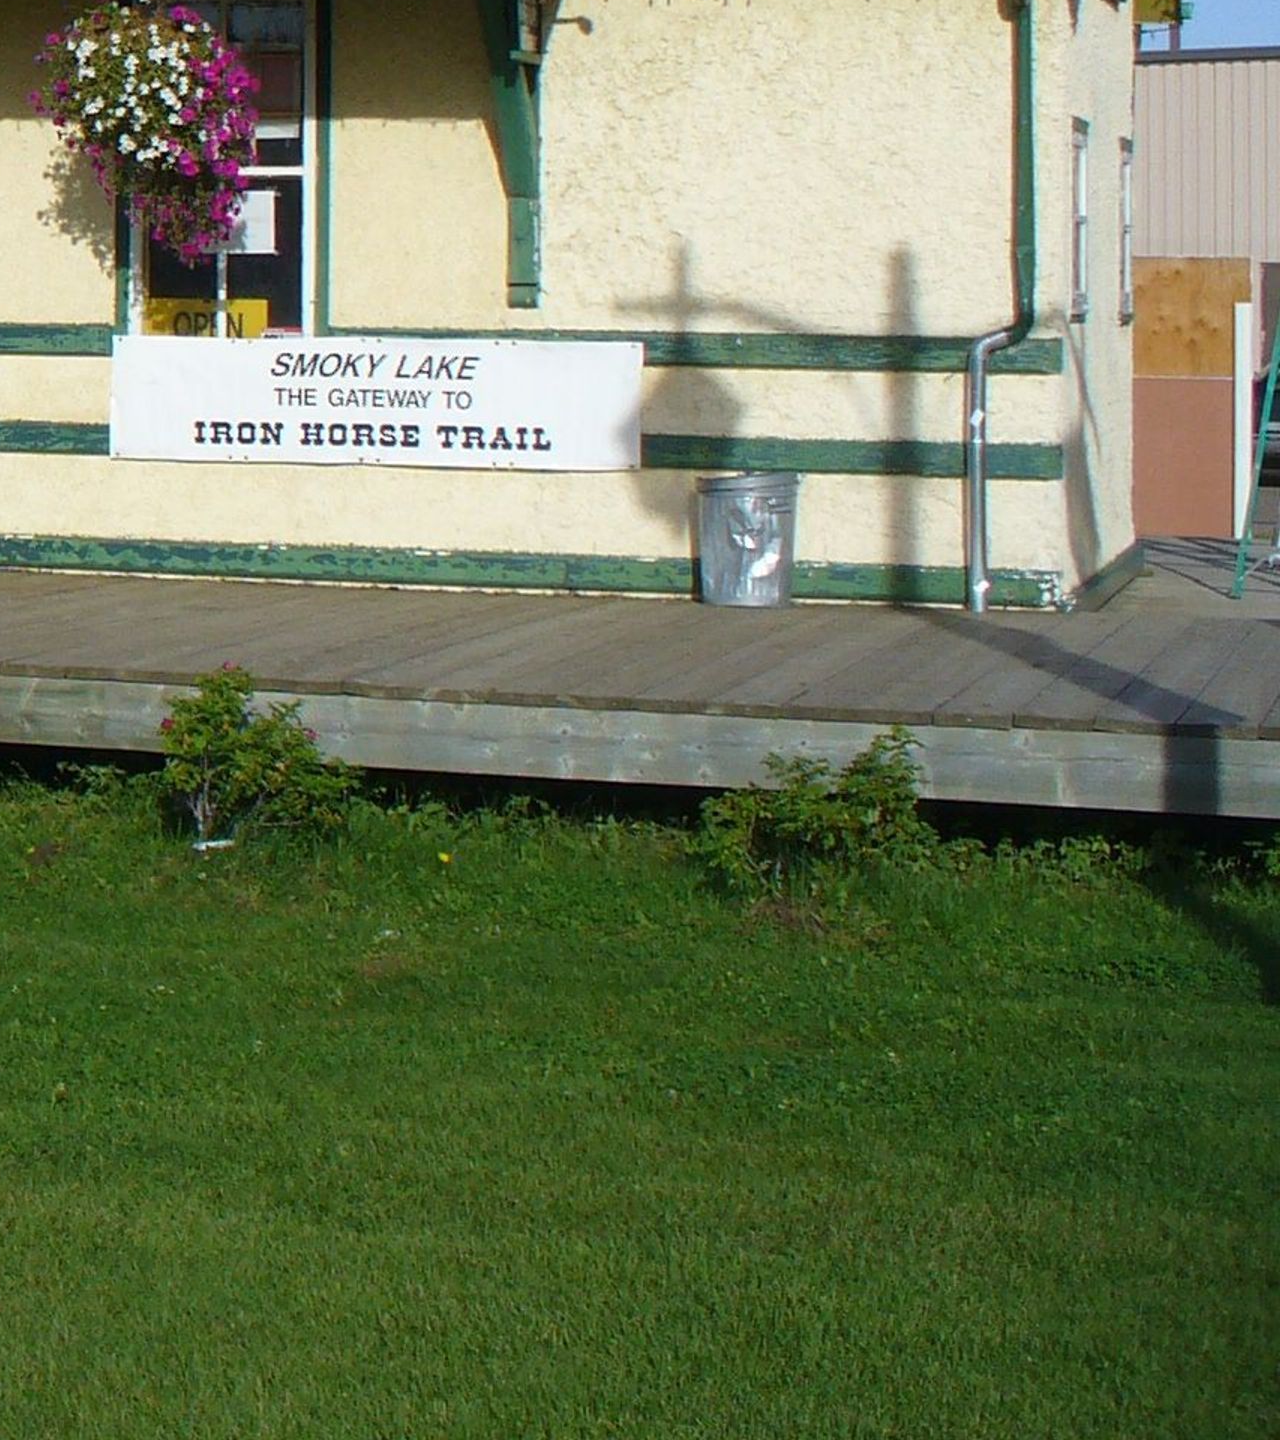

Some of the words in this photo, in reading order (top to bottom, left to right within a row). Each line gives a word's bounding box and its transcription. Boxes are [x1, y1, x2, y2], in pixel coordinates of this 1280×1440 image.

[270, 352, 386, 378] SMOKY
[395, 354, 480, 380] LAKE
[274, 388, 317, 407] THE
[328, 388, 432, 408] GATEWAY
[442, 391, 473, 410] TO
[194, 421, 284, 446] IRON
[300, 422, 420, 448] HORSE
[436, 425, 552, 451] TRAIL
